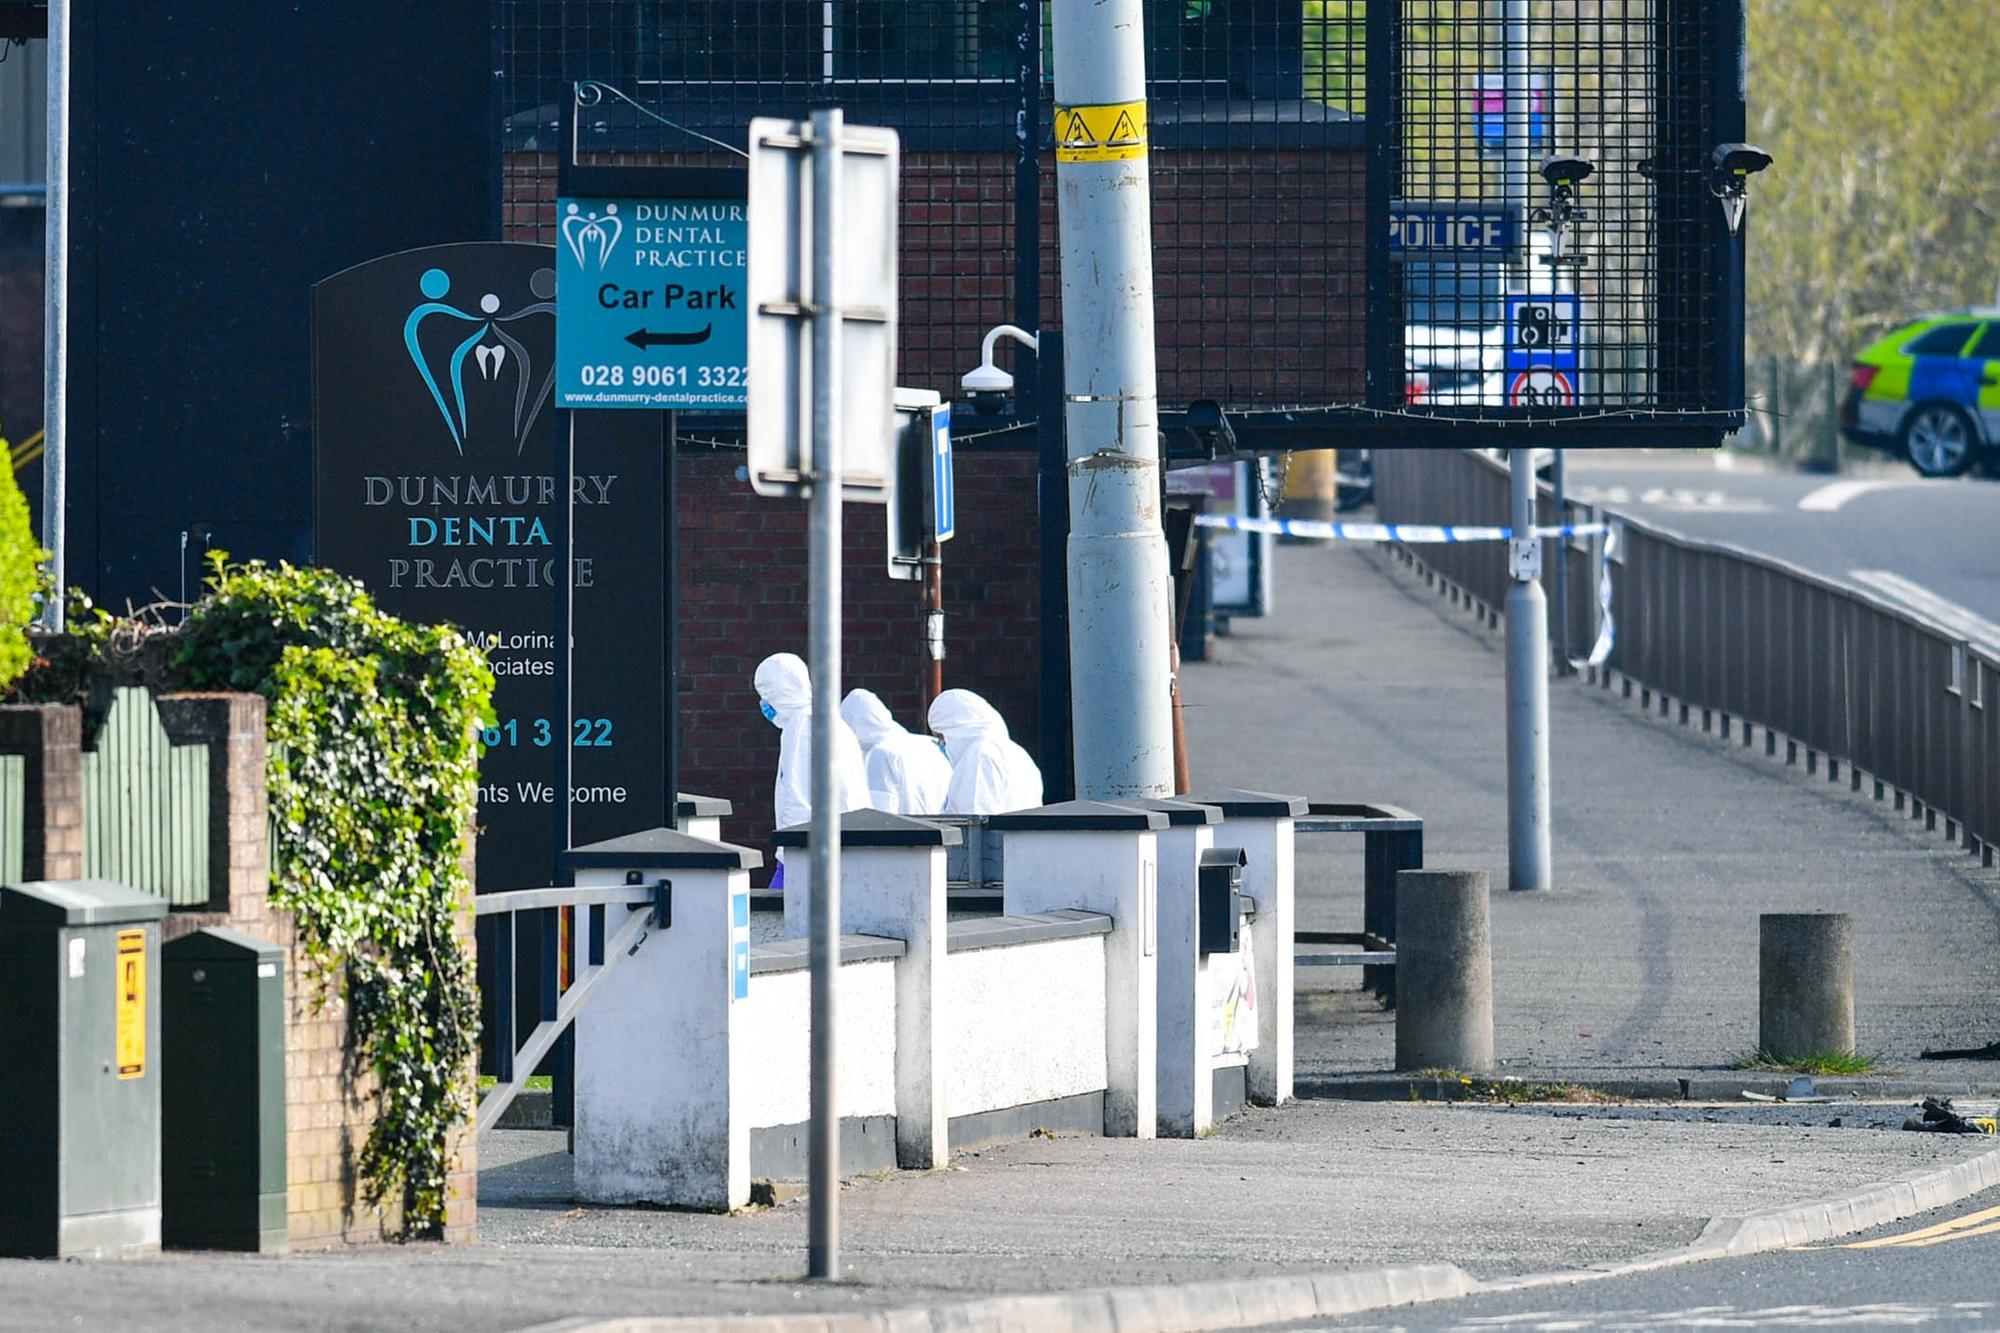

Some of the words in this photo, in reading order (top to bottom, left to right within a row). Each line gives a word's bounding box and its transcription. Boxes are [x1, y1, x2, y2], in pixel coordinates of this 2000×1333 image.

[636, 205, 748, 221] DUNMUR
[636, 227, 725, 244] DENTAL
[635, 249, 747, 268] PRACTICE
[598, 283, 653, 309] Car
[664, 284, 736, 309] Park
[581, 365, 624, 386] 028
[632, 365, 687, 386] 9061
[408, 516, 553, 546] DENTA
[533, 719, 613, 747] 322
